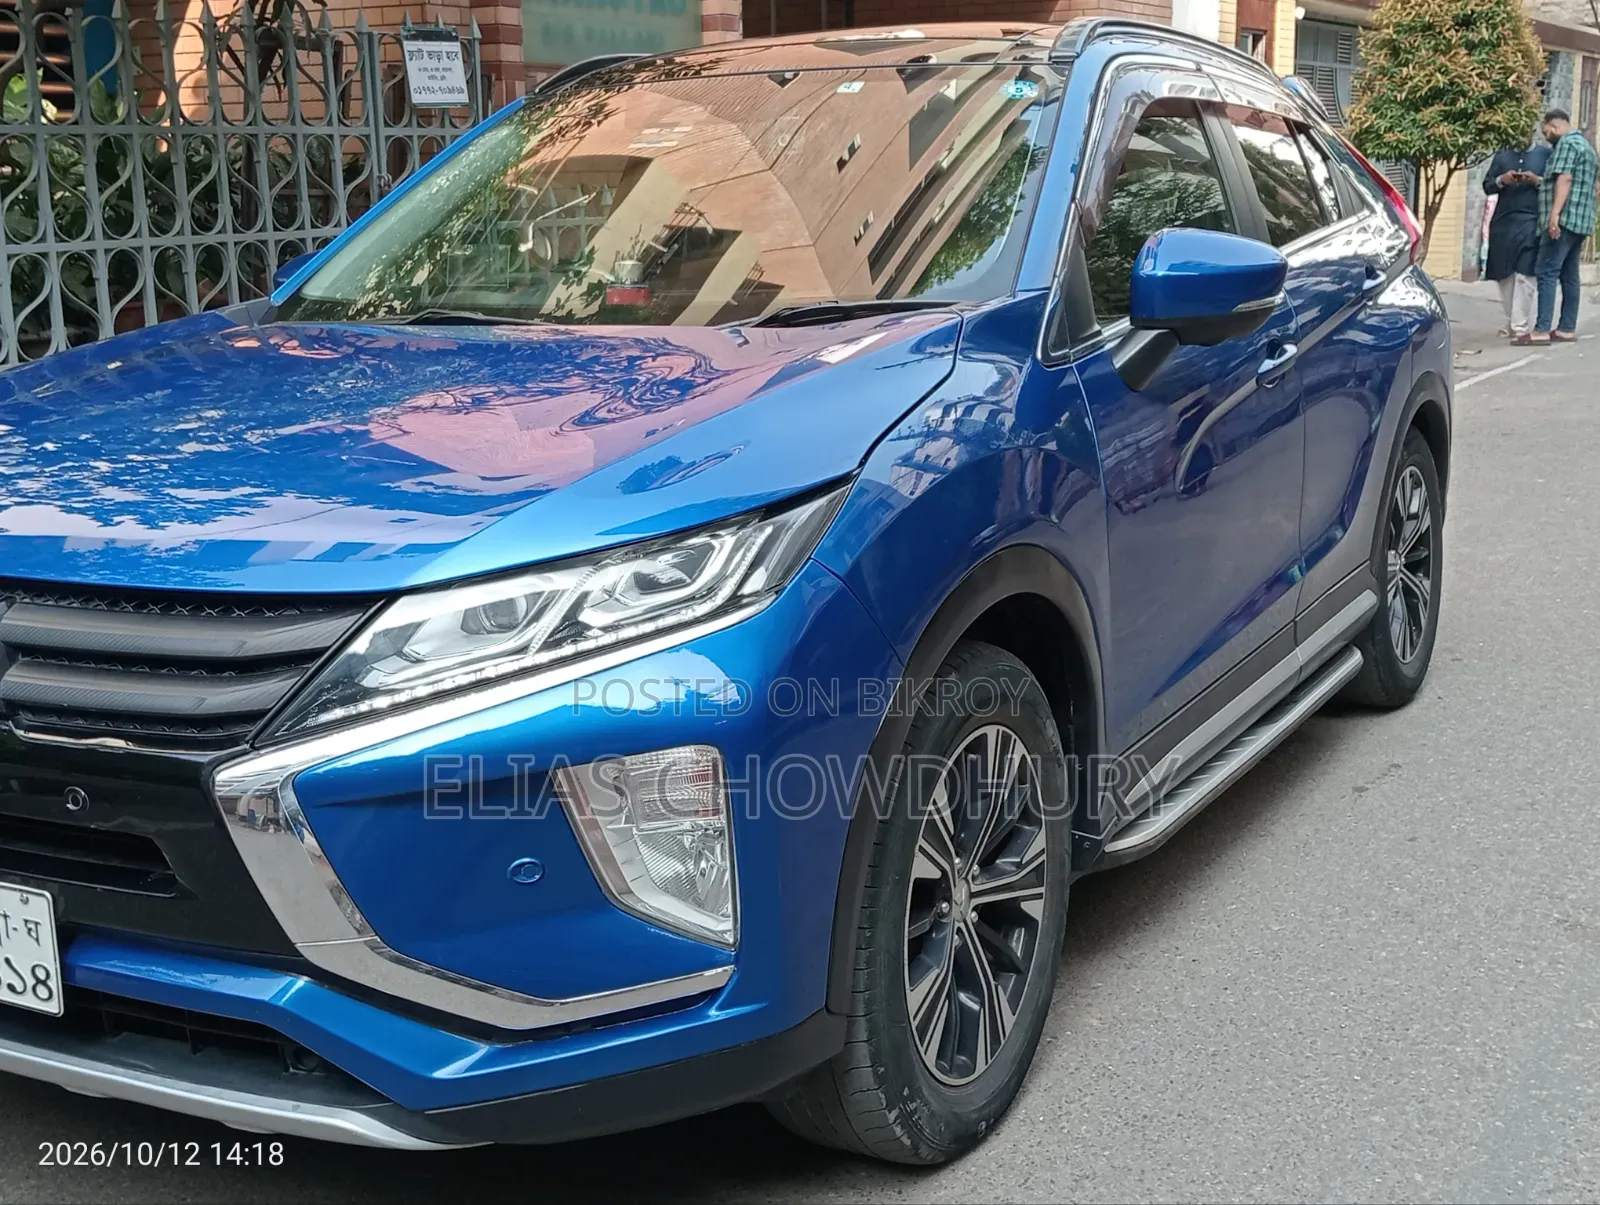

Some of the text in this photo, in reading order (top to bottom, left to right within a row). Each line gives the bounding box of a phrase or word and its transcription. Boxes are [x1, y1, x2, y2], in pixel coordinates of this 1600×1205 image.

[426, 50, 444, 63] ভাড়া
[445, 51, 459, 61] হবে
[0, 956, 53, 1001] ১৪
